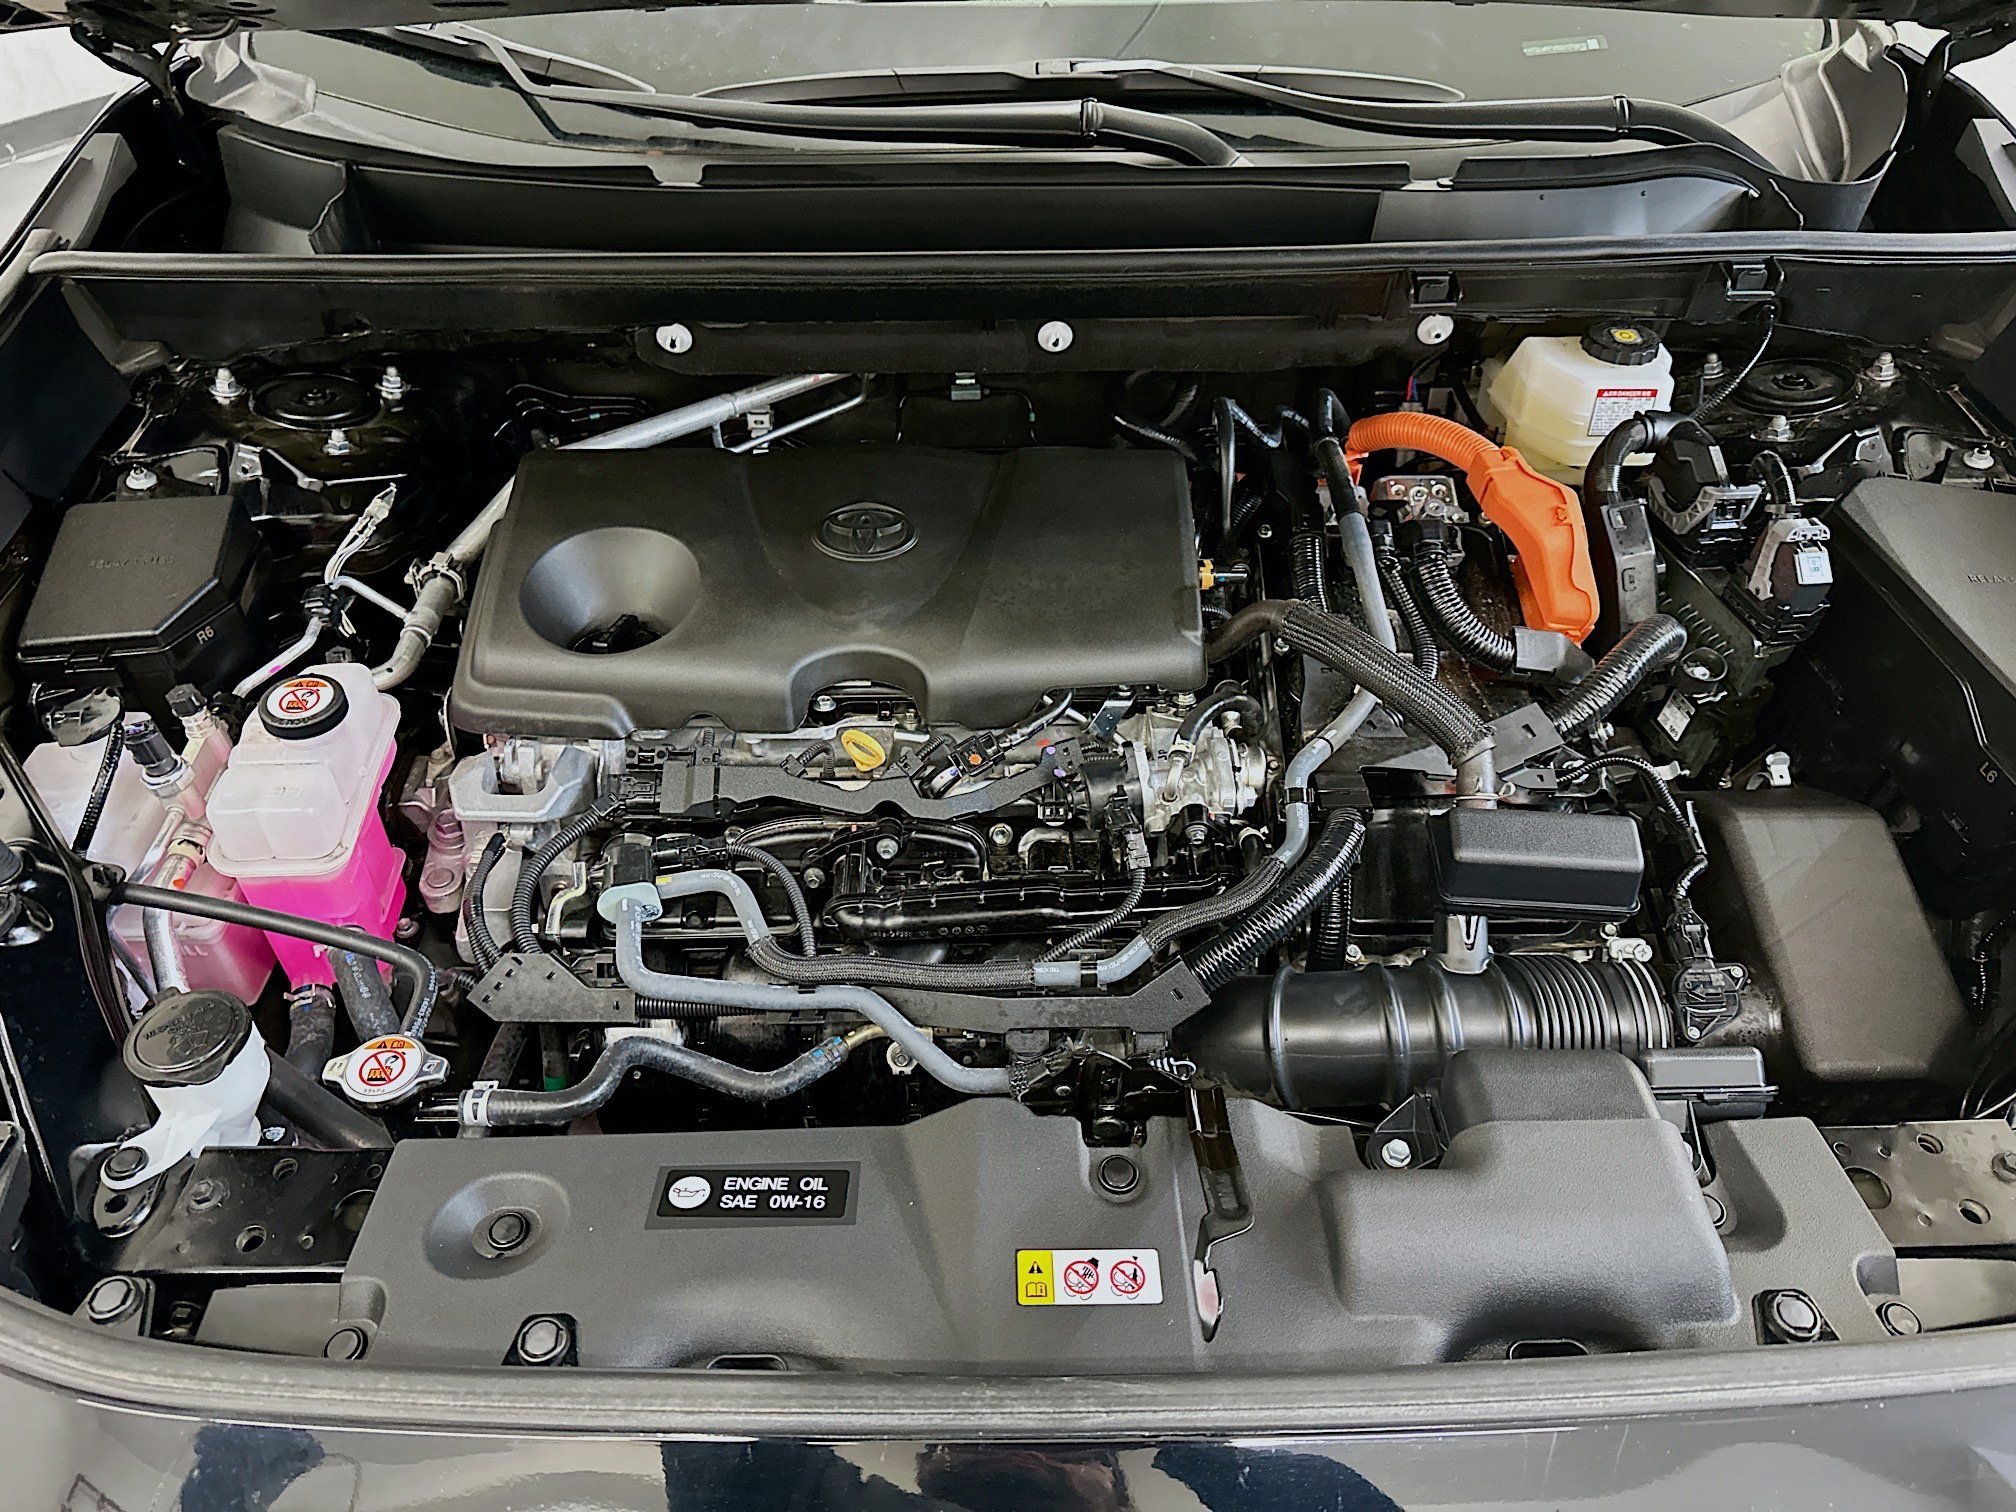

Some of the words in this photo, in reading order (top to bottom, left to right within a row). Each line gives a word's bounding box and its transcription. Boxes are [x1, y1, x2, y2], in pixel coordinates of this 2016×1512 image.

[196, 625, 215, 645] R6
[1979, 761, 1998, 783] L6
[723, 1177, 790, 1191] ENGINE
[799, 1177, 829, 1191] OIL
[719, 1194, 758, 1209] SAE
[769, 1194, 826, 1209] 0W-16
